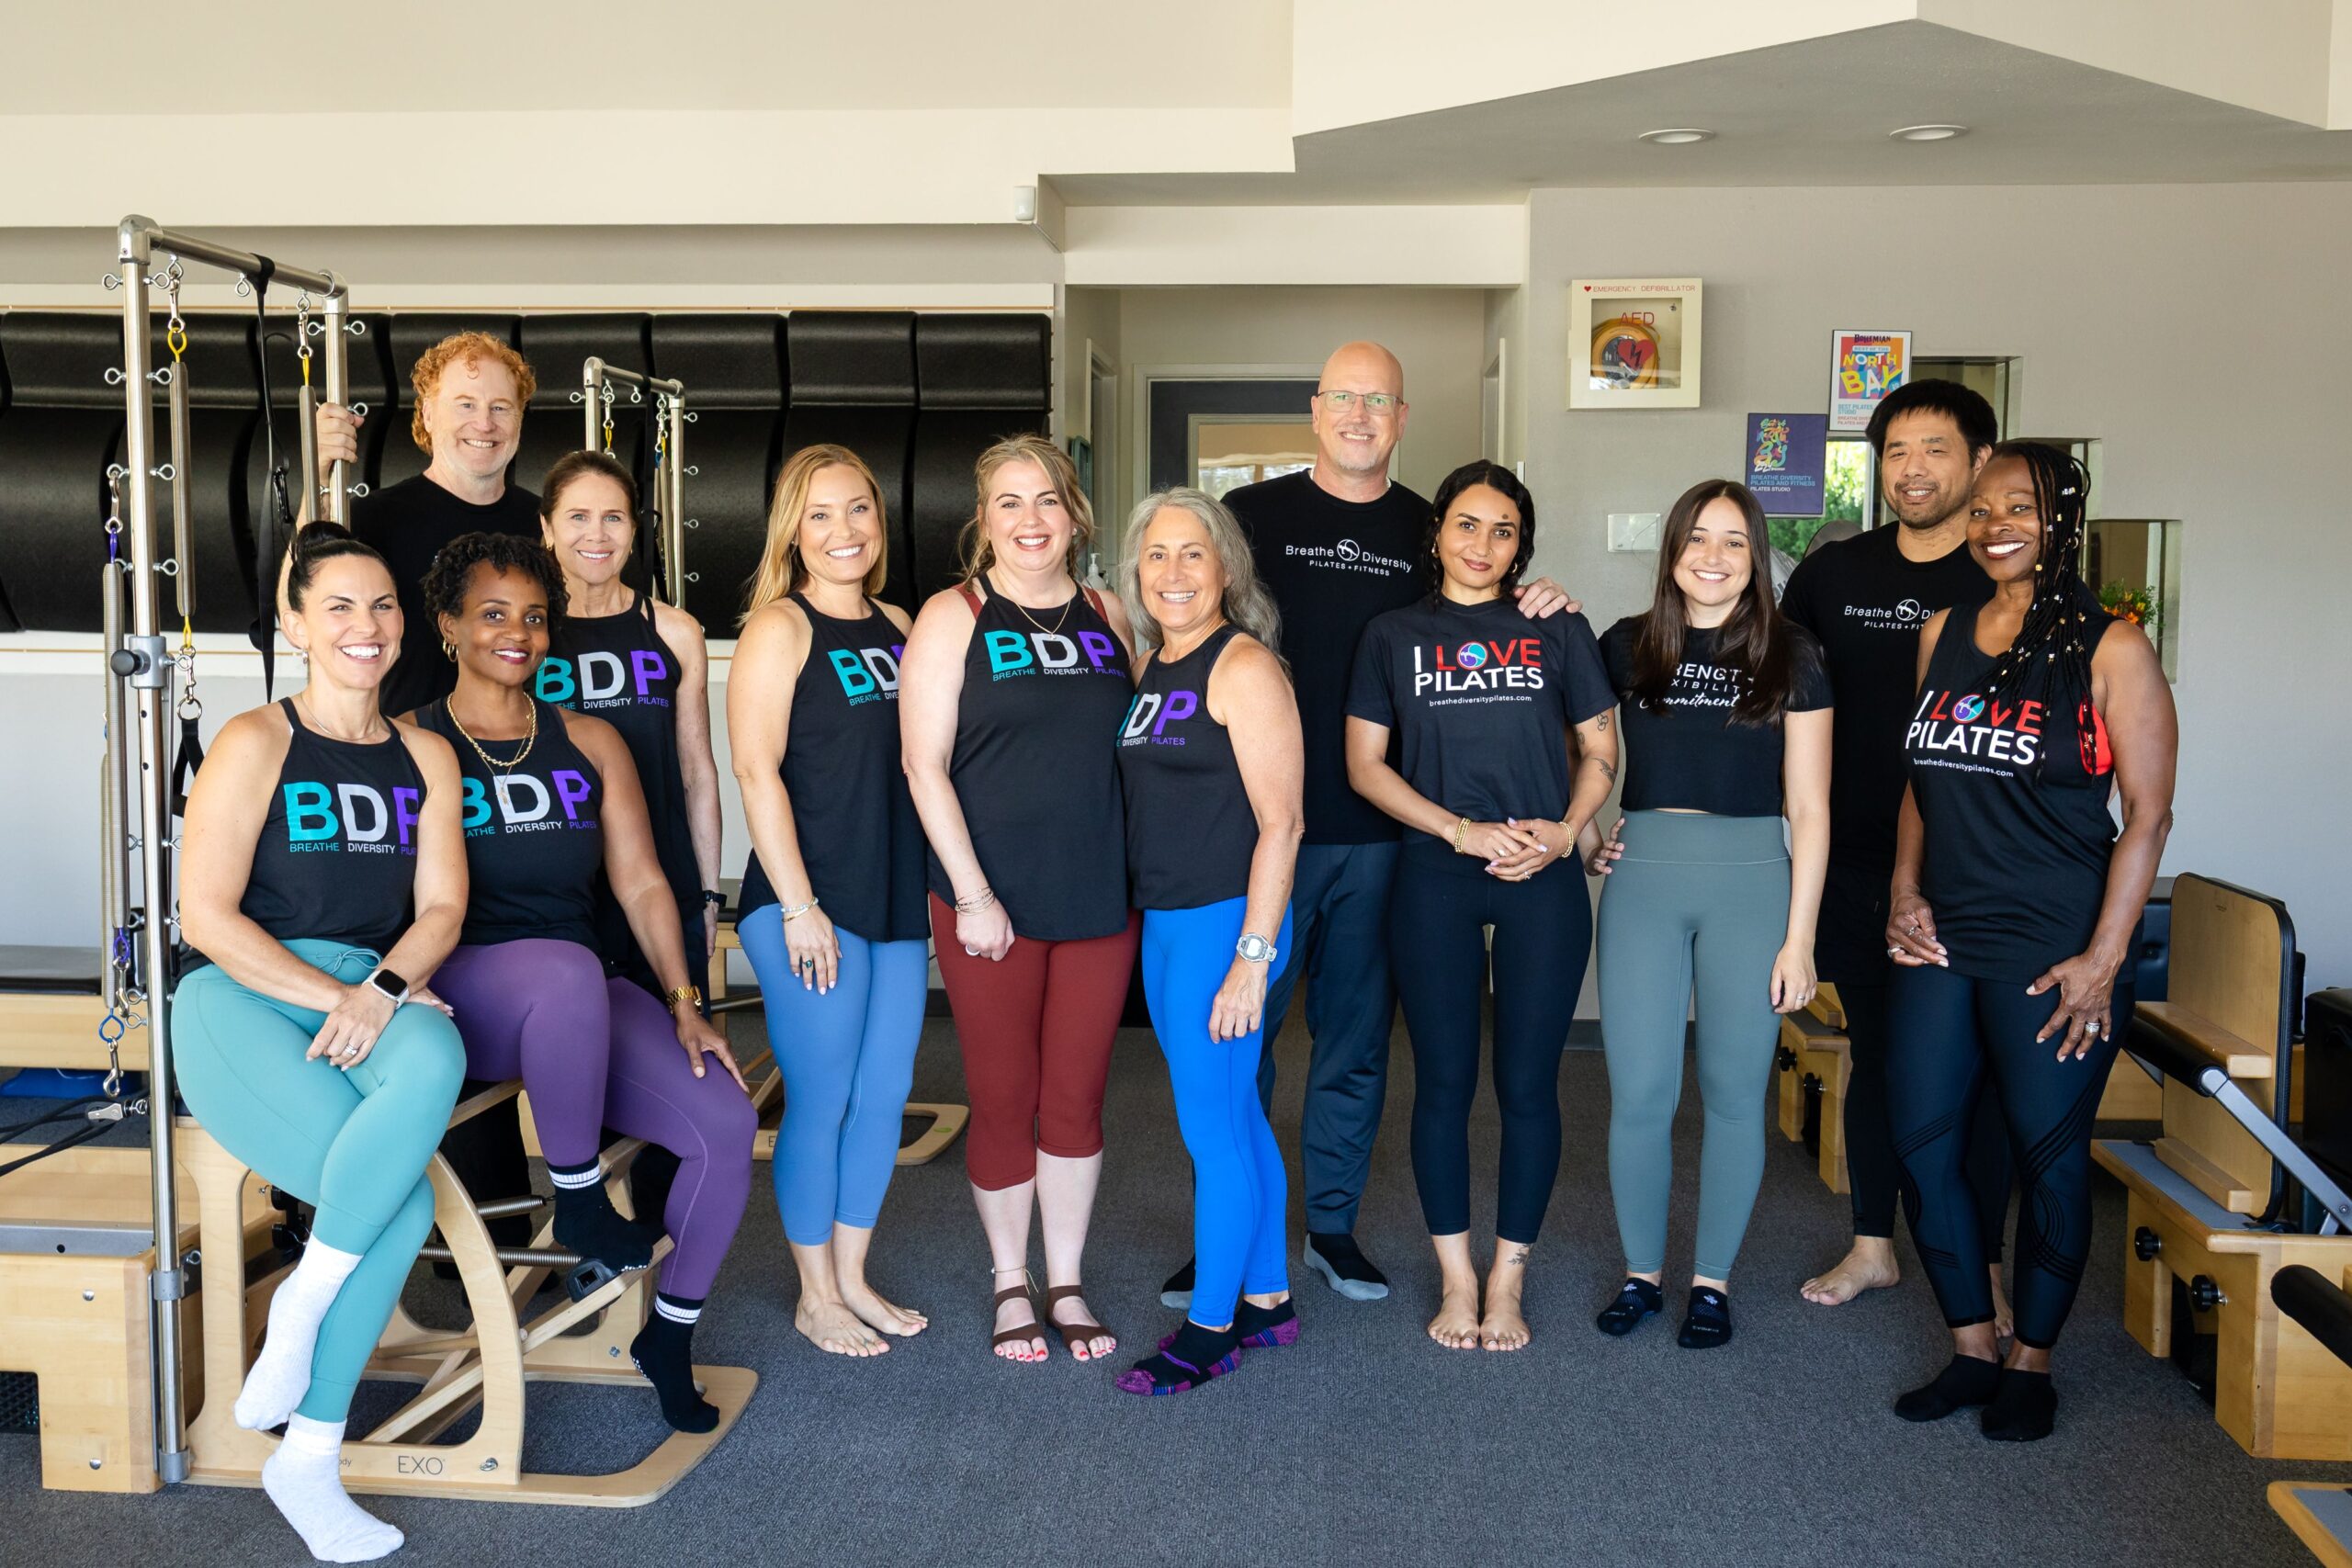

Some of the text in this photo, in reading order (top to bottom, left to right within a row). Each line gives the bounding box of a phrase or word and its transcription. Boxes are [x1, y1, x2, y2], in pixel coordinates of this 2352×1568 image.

[1618, 311, 1655, 326] AED
[1843, 353, 1897, 367] NORTH
[1840, 366, 1903, 398] BAY
[1285, 545, 1412, 573] Breathe Diversity
[1309, 559, 1346, 570] PILATES
[1353, 565, 1391, 577] FITNESS
[1844, 605, 1893, 619] Breathe
[1863, 621, 1902, 629] PILATES
[1414, 639, 1541, 673] I LOVE
[828, 644, 905, 697] BD
[992, 668, 1036, 682] BREATHE
[1043, 667, 1090, 676] DIVERSITY
[1415, 666, 1544, 696] PILATES
[583, 697, 632, 709] DIVERSITY
[638, 696, 670, 707] PILATES
[849, 693, 882, 706] BREATHE
[1429, 694, 1532, 707] breathediversitypilates.com
[1122, 736, 1148, 747] DIVERSITY
[1151, 736, 1186, 746] PILATES
[1905, 720, 2040, 765] PILATES
[1913, 757, 2014, 778] breathediversitypilates.com
[505, 820, 563, 834] DIVERSITY
[289, 842, 340, 853] BREATHE
[347, 842, 396, 854] DIVERSITY
[398, 1455, 444, 1475] EXO
